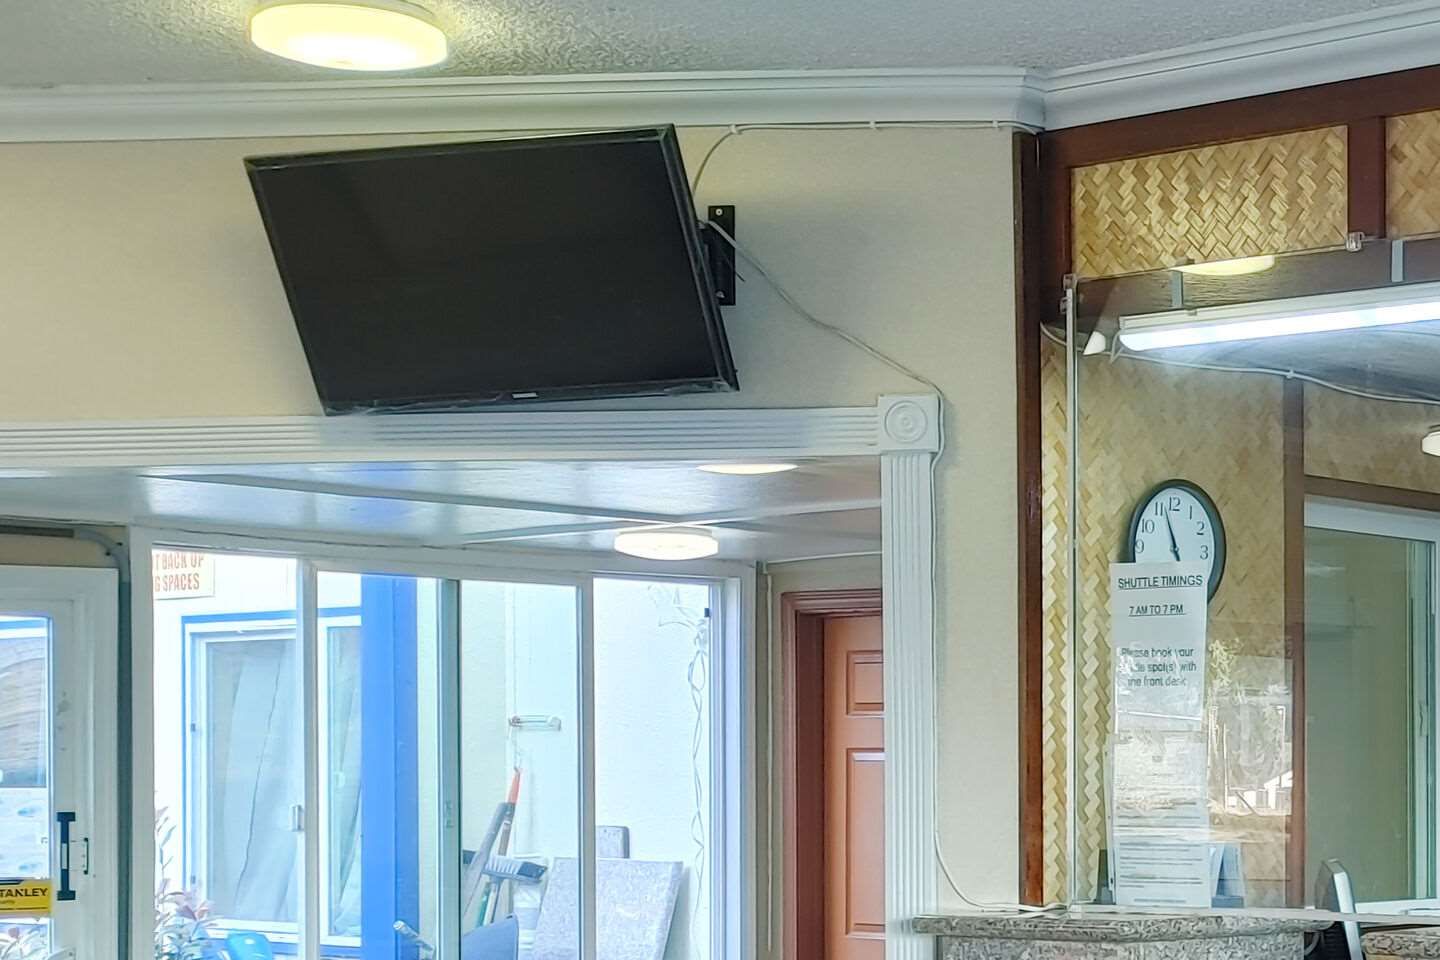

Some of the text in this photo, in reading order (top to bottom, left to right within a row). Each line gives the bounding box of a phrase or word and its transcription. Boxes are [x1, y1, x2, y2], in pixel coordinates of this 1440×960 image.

[1155, 501, 1164, 516] 11
[1169, 496, 1181, 511] 12
[1189, 505, 1193, 520] 1
[1141, 518, 1155, 534] 10
[1196, 521, 1205, 535] 2
[1135, 539, 1144, 553] 9
[1199, 545, 1209, 560] 3
[162, 572, 200, 592] SPACES
[1118, 575, 1203, 588] SHUTTLE TIMINGS
[1135, 606, 1148, 614] AM
[1149, 605, 1160, 614] TO
[1170, 604, 1184, 613] PM
[1151, 647, 1172, 657] book
